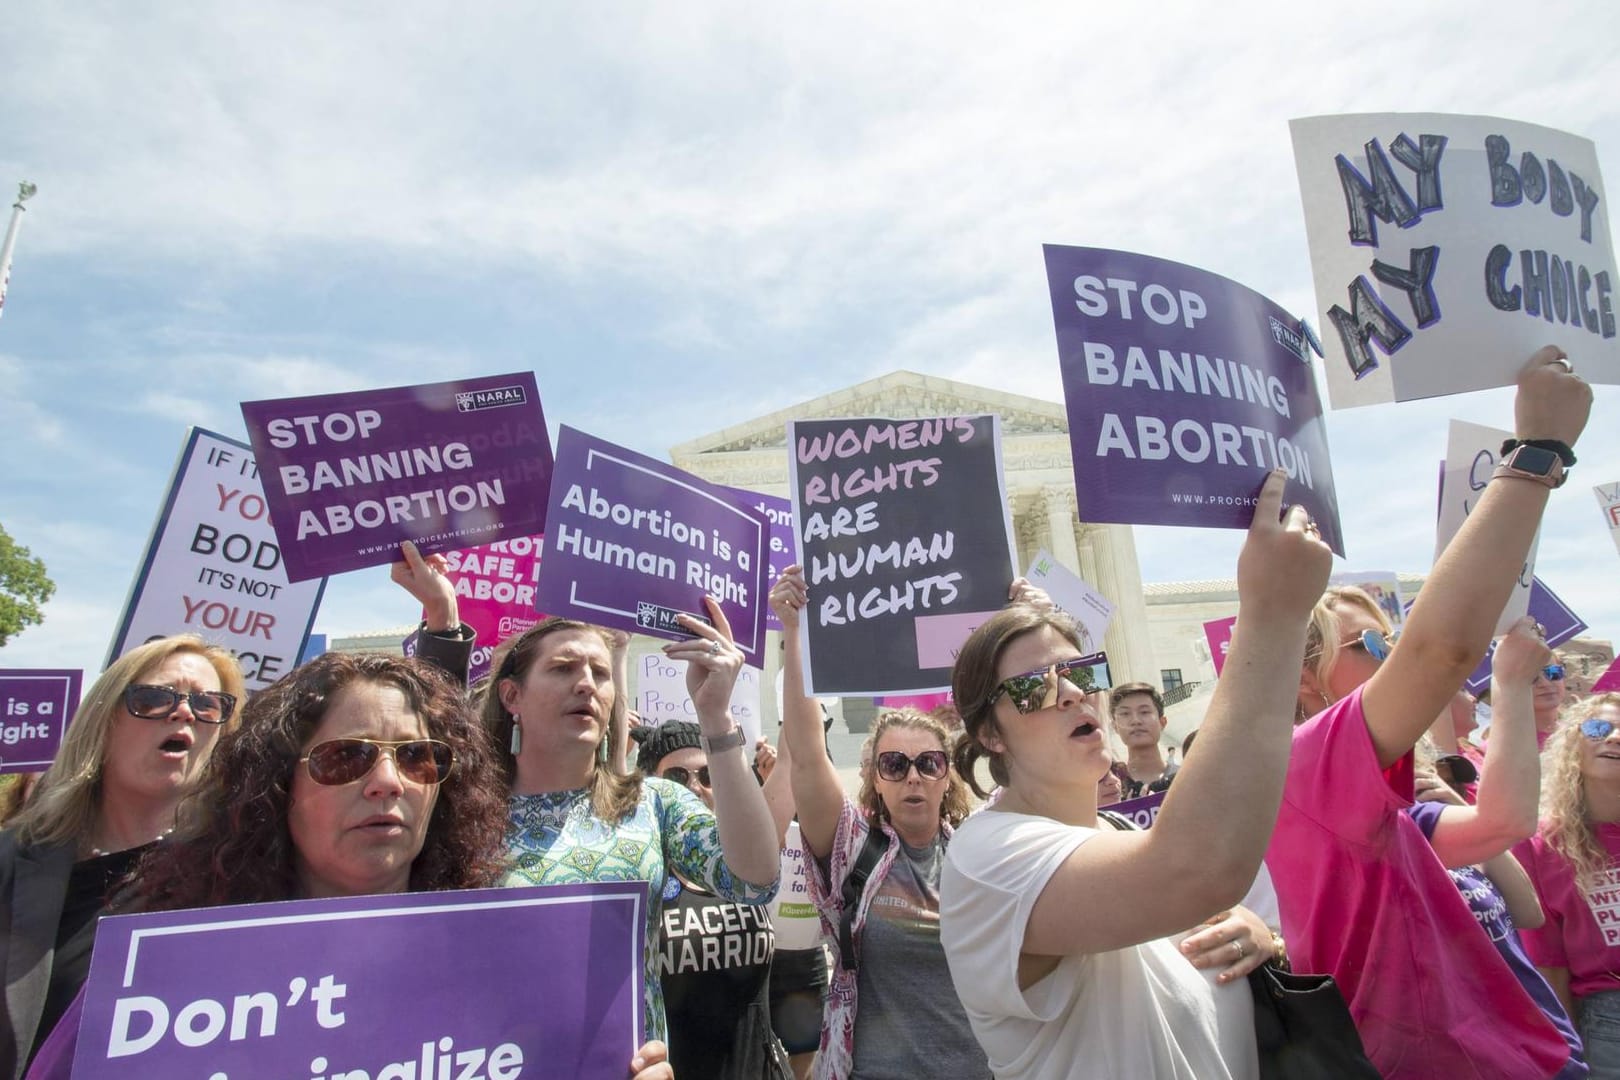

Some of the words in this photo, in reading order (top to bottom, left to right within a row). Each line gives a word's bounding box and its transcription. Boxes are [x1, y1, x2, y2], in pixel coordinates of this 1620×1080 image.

[1334, 132, 1448, 248] MY
[1485, 134, 1599, 244] BODY
[1073, 275, 1208, 329] STOP
[1326, 245, 1442, 380] MY
[1485, 244, 1616, 339] CHOICE
[477, 389, 521, 402] NARAL
[1083, 341, 1291, 419] BANNING
[267, 410, 382, 449] STOP
[797, 417, 976, 464] WOMEN'S
[1096, 413, 1313, 490] ABORTION
[207, 447, 234, 467] IF
[280, 442, 473, 496] BANNING
[805, 457, 943, 505] RIGHTS
[217, 483, 273, 526] YO
[296, 478, 506, 541] ABORTION
[561, 484, 706, 550] Abortion
[712, 529, 731, 561] is
[737, 552, 750, 571] a
[803, 501, 880, 543] ARE
[446, 551, 524, 582] SAFE,
[557, 523, 676, 580] Human
[686, 560, 748, 607] Right
[812, 531, 955, 585] HUMAN
[198, 567, 235, 590] IT'S
[238, 577, 282, 600] NOT
[456, 577, 538, 606] ABOR
[820, 572, 963, 627] RIGHTS
[182, 595, 276, 640] YOUR
[7, 698, 29, 715] is
[37, 702, 53, 715] a
